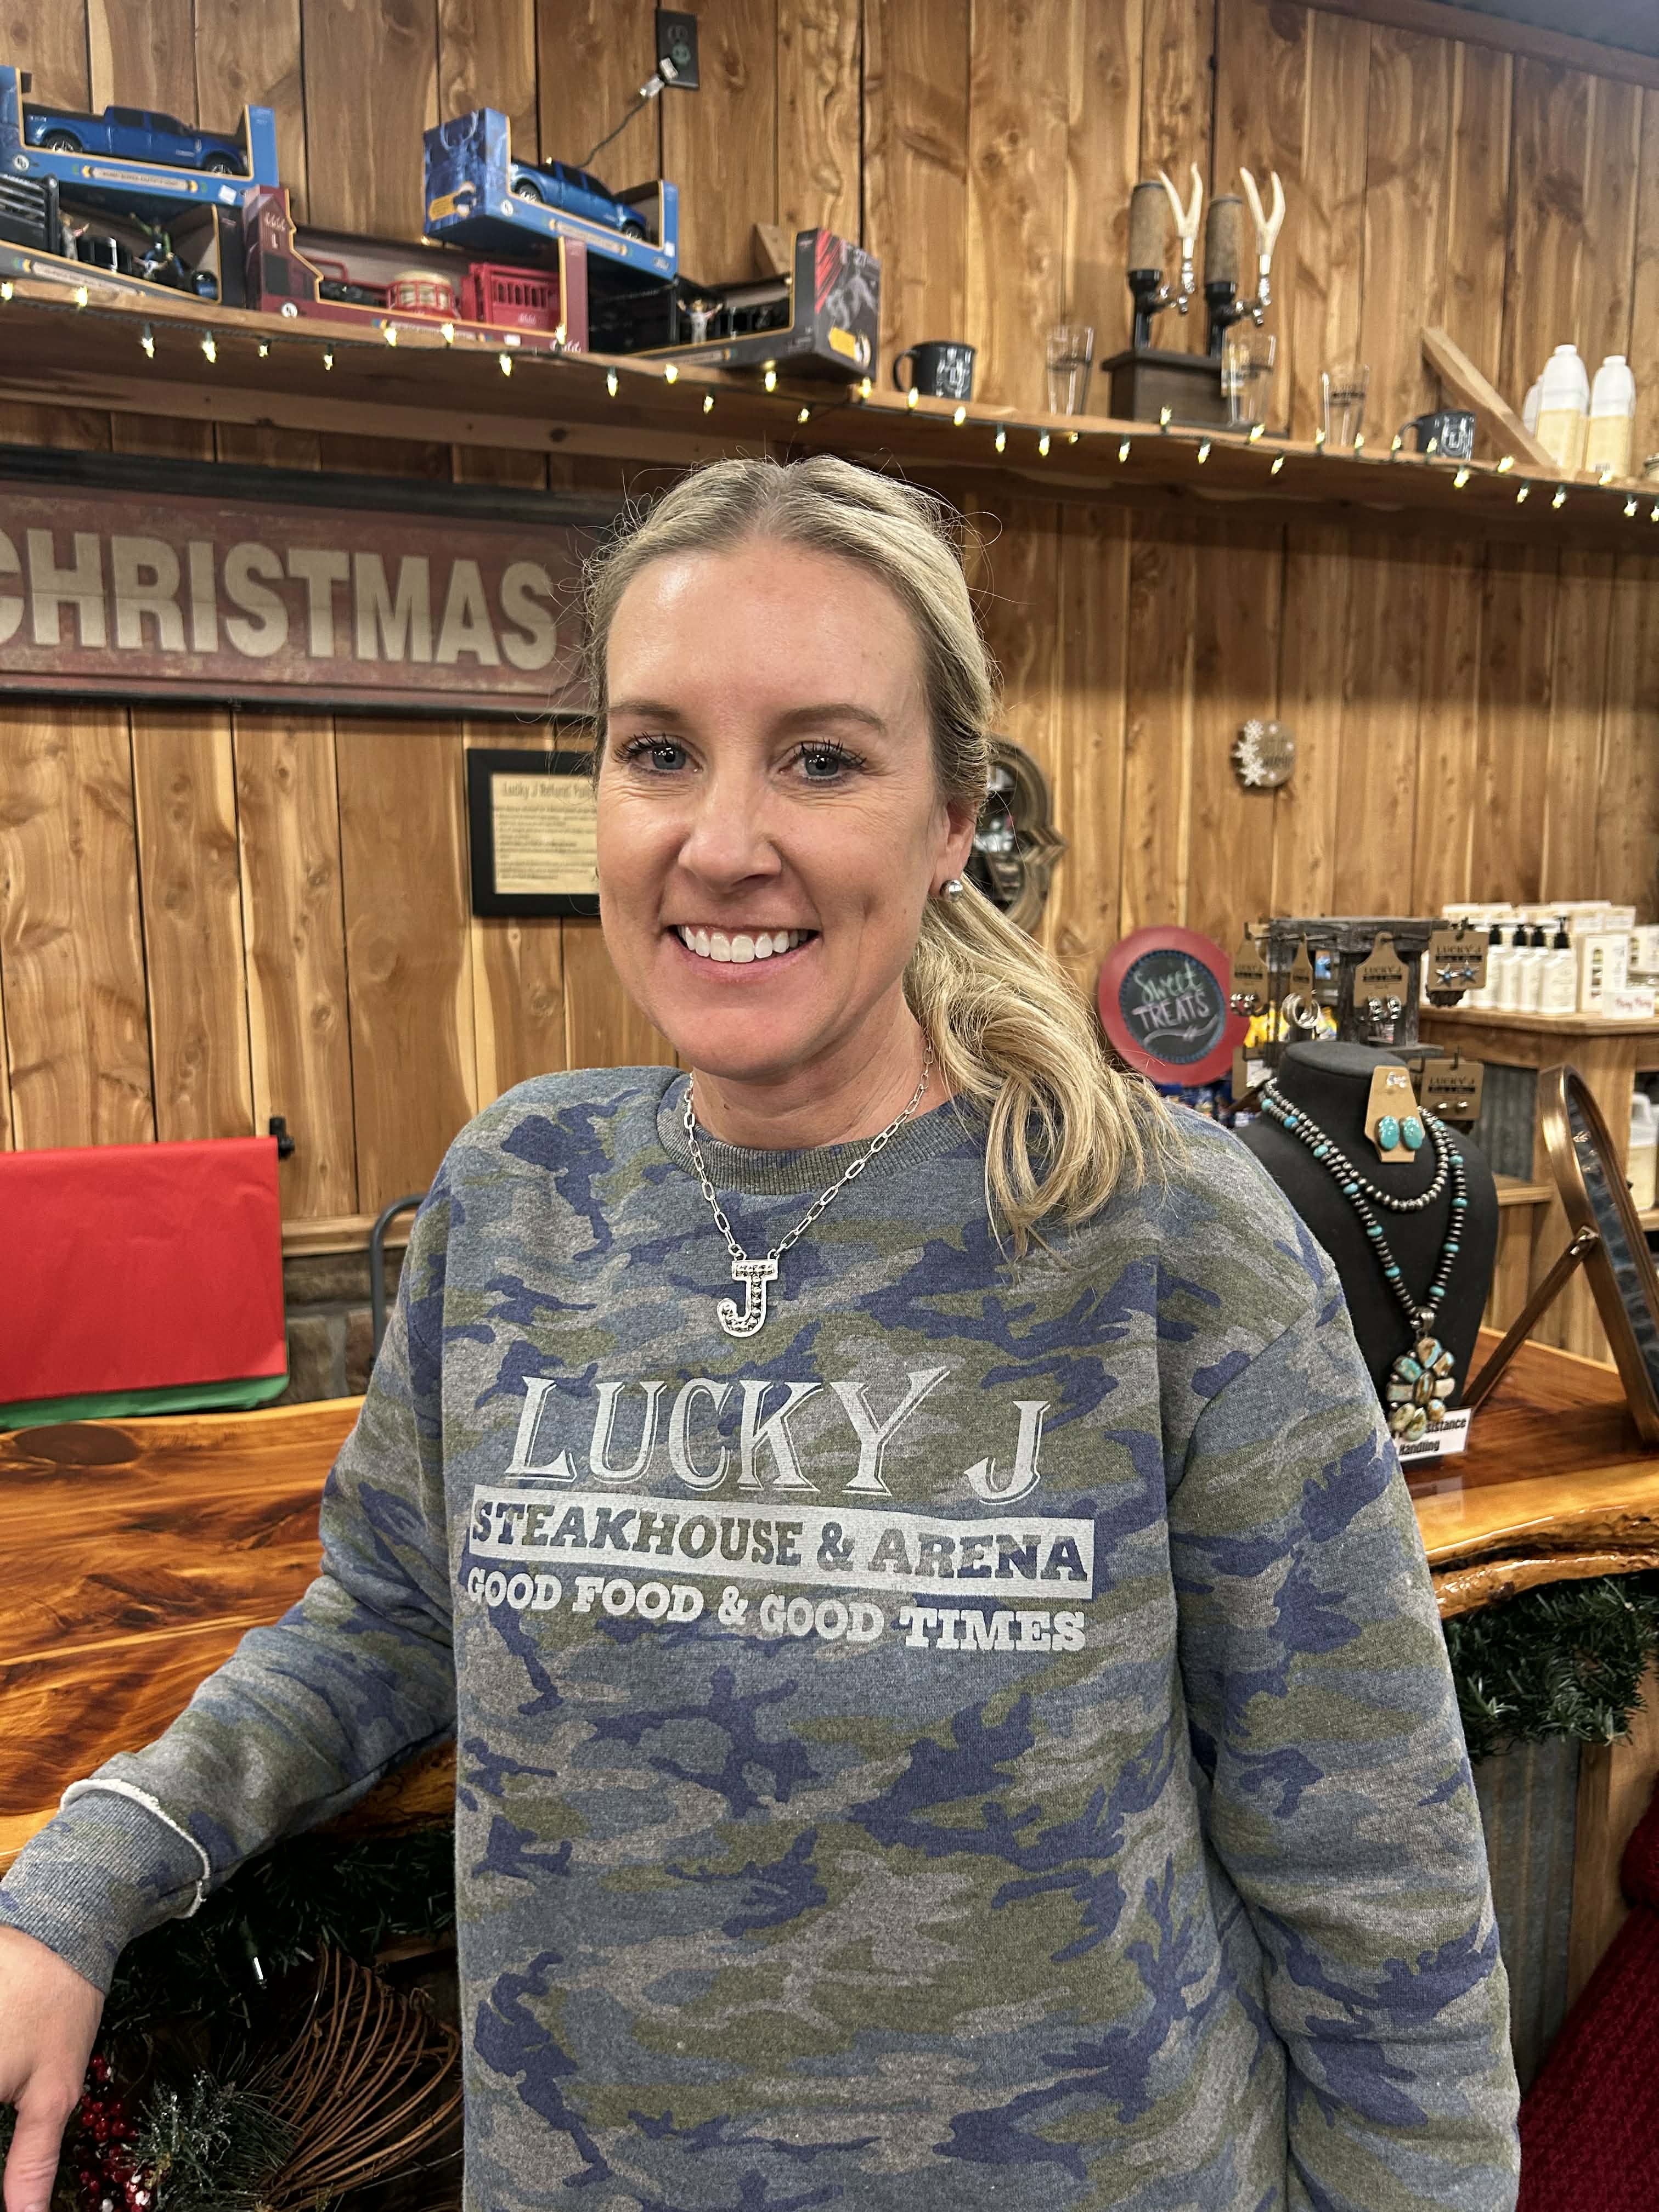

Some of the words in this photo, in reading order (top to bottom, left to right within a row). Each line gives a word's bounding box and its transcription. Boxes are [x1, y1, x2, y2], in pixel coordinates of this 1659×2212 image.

[1132, 991, 1210, 1032] TREATS
[1133, 961, 1203, 1005] Sweet
[505, 1367, 950, 1497] LUCKY
[963, 1401, 1051, 1505] J
[472, 1499, 803, 1567] STEAKHOUSE
[817, 1522, 855, 1572] &
[867, 1528, 1087, 1581] ARENA
[468, 1567, 562, 1610] GOOD
[572, 1576, 704, 1622] FOOD
[718, 1585, 748, 1625] &
[760, 1594, 885, 1643] GOOD
[899, 1606, 1085, 1651] TIMES
